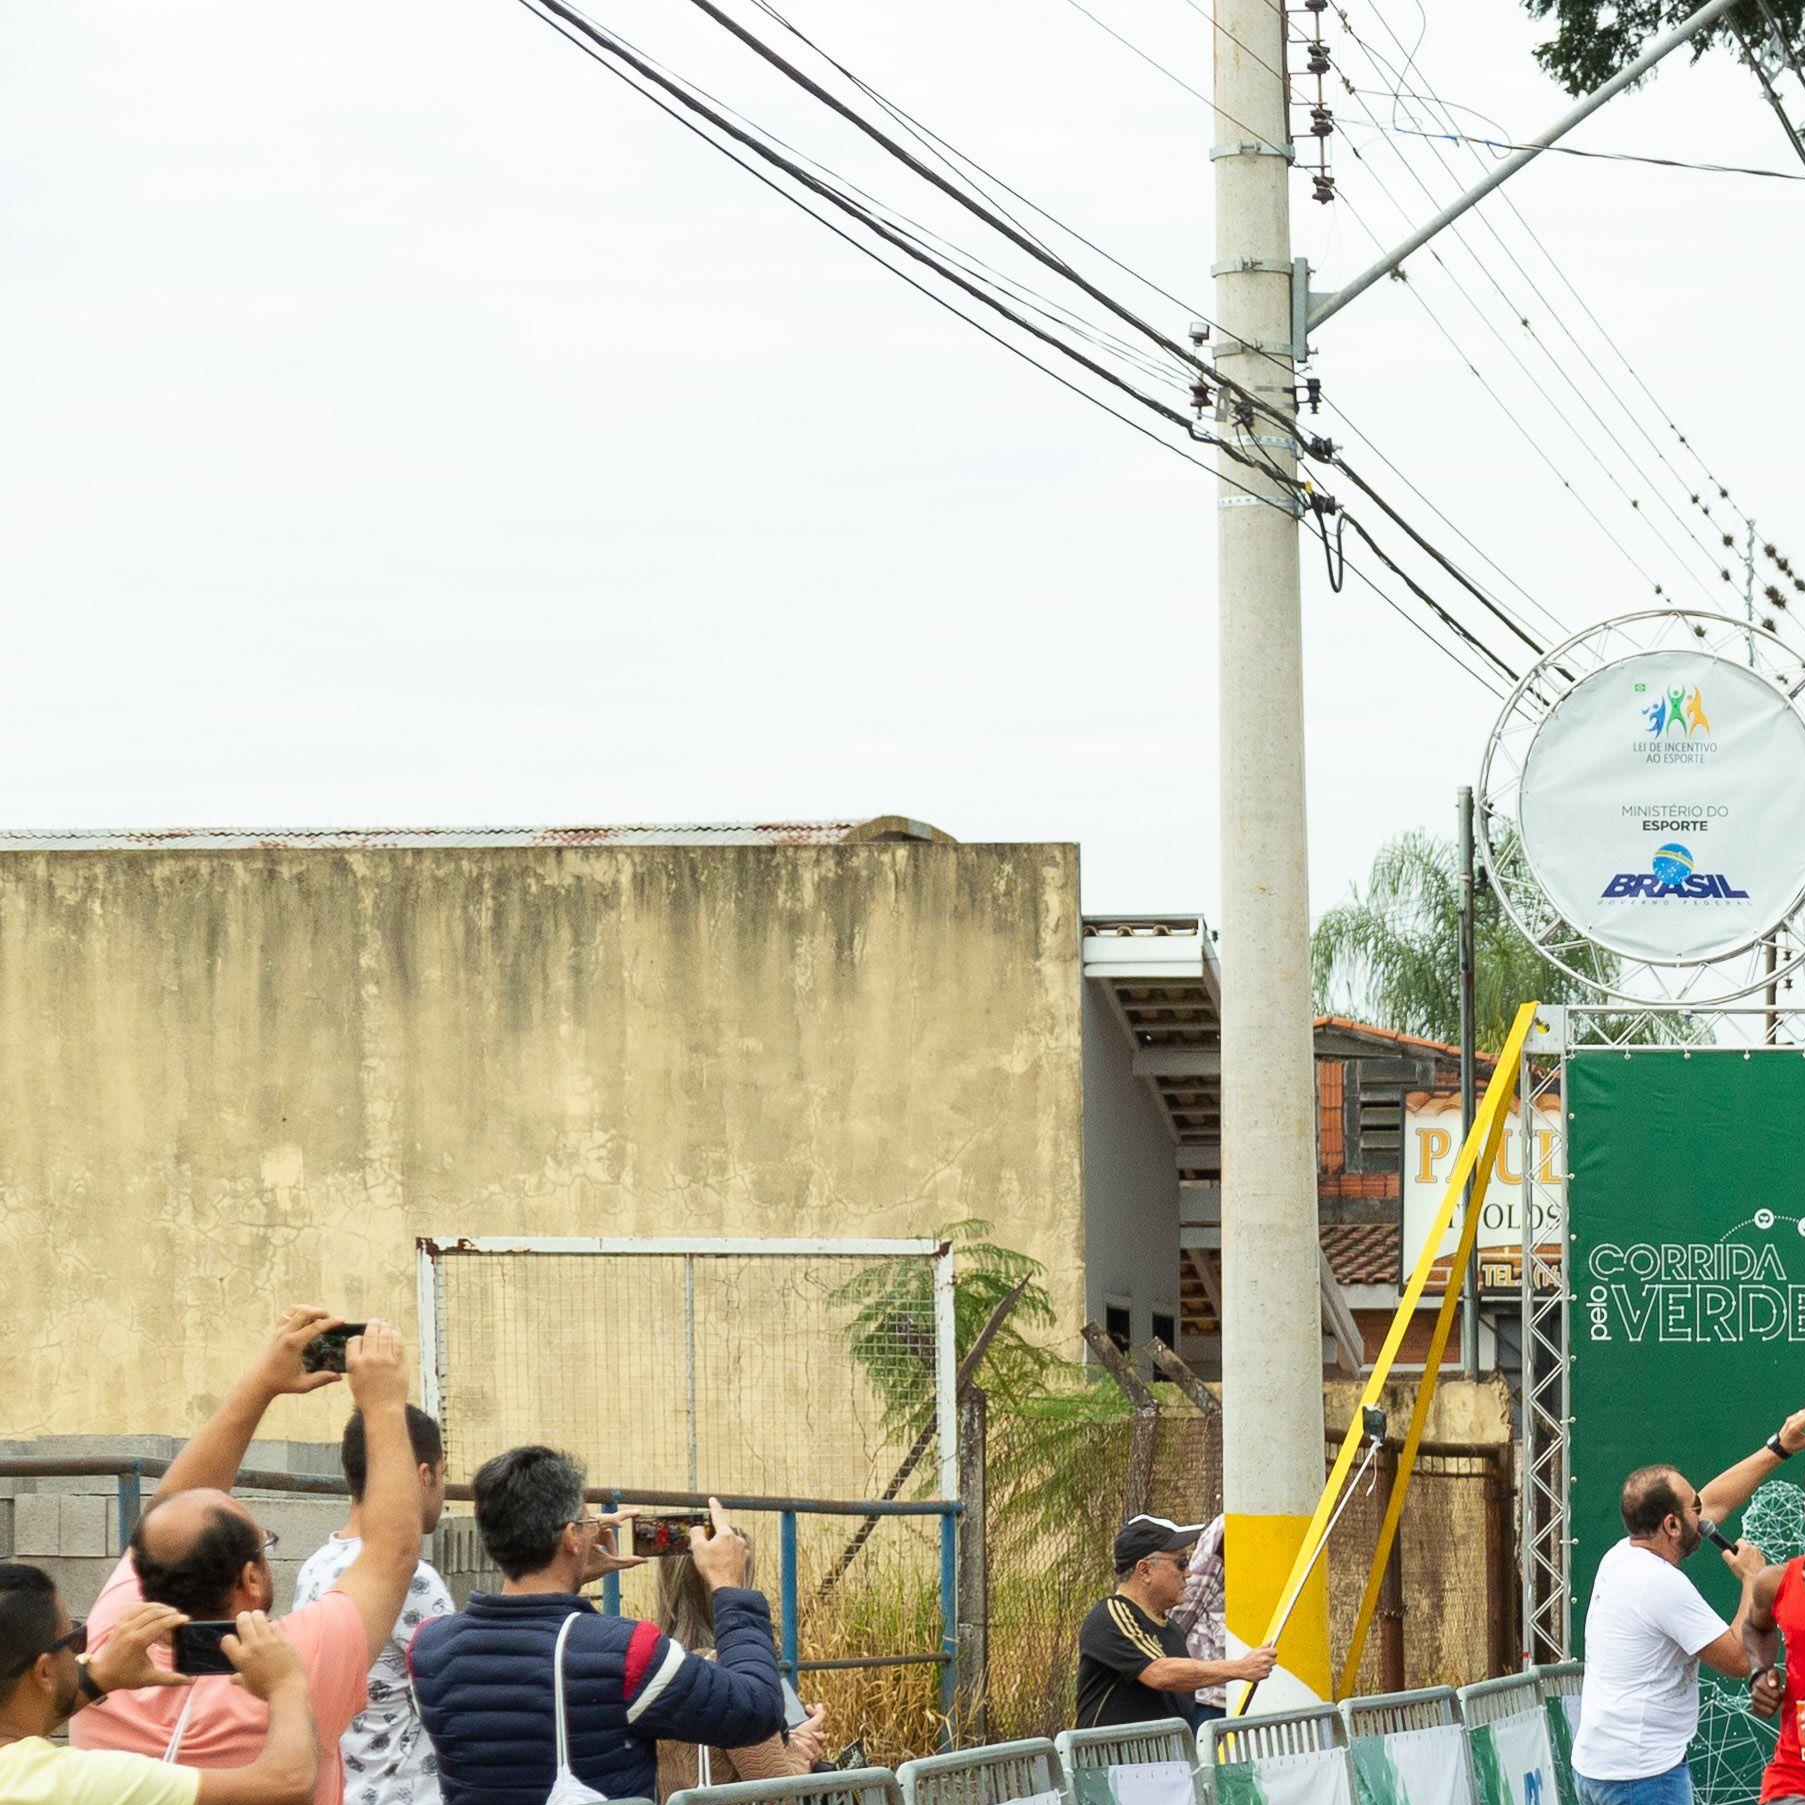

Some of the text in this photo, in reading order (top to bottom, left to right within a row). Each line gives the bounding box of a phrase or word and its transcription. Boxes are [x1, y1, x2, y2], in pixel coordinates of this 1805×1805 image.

[1633, 742, 1717, 752] LEI DE INCENTIVO
[1646, 753, 1706, 764] AO ESPORTE
[1621, 804, 1729, 818] MINISTÉRIO DO
[1642, 820, 1708, 831] ESPORTE
[1600, 873, 1751, 899] BRASIL
[1588, 1243, 1787, 1282] CORRIDA
[1586, 1286, 1612, 1341] pelo
